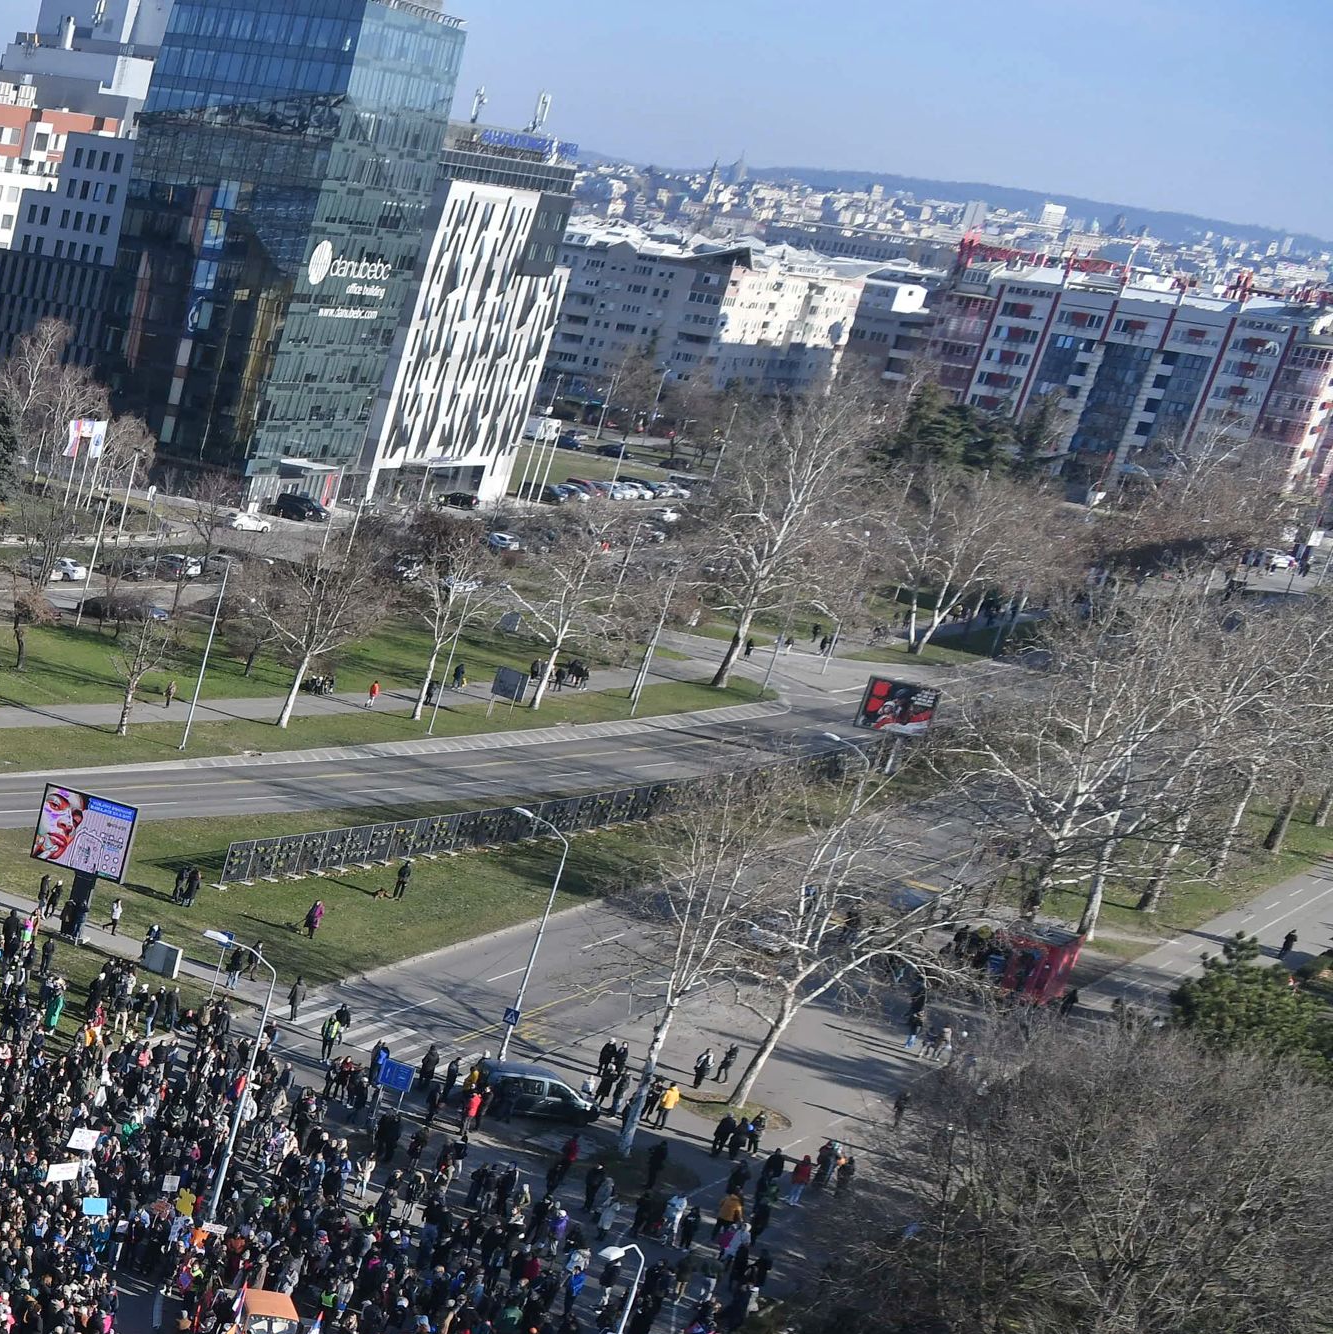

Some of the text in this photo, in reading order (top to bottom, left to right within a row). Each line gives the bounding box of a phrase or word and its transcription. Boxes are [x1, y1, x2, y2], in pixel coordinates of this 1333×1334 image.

[330, 255, 391, 280] danubebc
[346, 283, 386, 300] office building
[318, 307, 378, 319] www.danubebc.com
